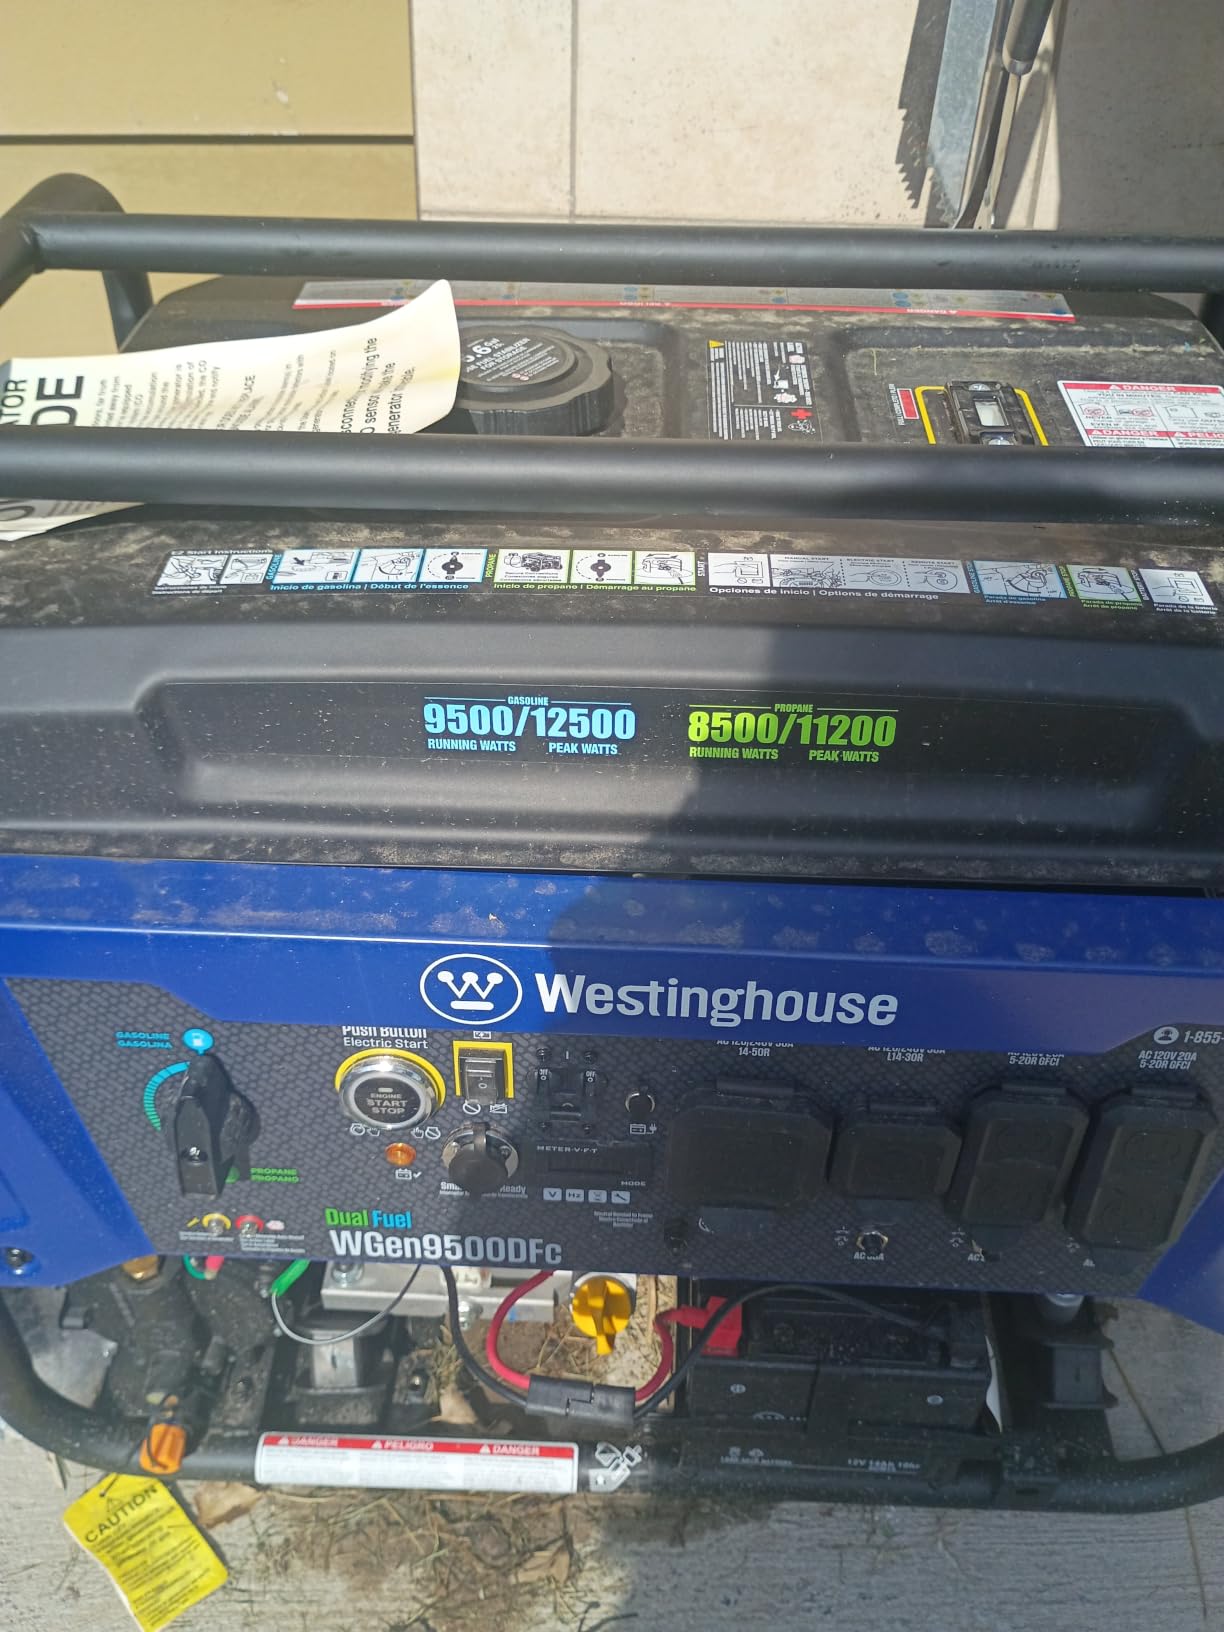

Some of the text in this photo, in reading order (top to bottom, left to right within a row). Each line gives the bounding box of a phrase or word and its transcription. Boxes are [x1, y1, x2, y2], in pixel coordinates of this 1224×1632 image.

[265, 553, 282, 580] GASOLINE
[485, 553, 497, 578] PROPANE
[697, 560, 706, 576] START
[586, 584, 639, 592] Démarrage
[656, 585, 697, 593] propane
[709, 586, 761, 595] Opciones
[764, 587, 777, 595] de
[819, 589, 861, 599] Options
[881, 591, 939, 600] démarrage
[507, 696, 549, 706] GASOLINE
[774, 703, 814, 713] PROPANE
[423, 703, 636, 740] 9500/12500
[688, 711, 897, 747] 8500/11200
[427, 738, 516, 752] RUNNING WATTS
[549, 742, 618, 755] PEAK WATTS
[689, 746, 779, 760] RUNNING WATTS
[808, 749, 880, 763] PEAK WATTS
[535, 973, 898, 1028] Westinghouse
[116, 1031, 170, 1040] GASOLINE
[117, 1040, 172, 1049] GASOLINA
[343, 1037, 428, 1049] Electric Start
[738, 1047, 770, 1057] 14-50R
[887, 1052, 924, 1063] L14-30R
[1139, 1050, 1197, 1061] AC 120V 20A
[1009, 1056, 1060, 1067] 5-20R GFCI
[1139, 1059, 1191, 1070] 5-20R GFCI
[366, 1099, 408, 1107] START
[371, 1107, 406, 1115] STOP
[251, 1175, 299, 1183] PROPANO
[325, 1207, 412, 1229] Dual Fuel
[329, 1230, 562, 1265] WGen9500DFc
[853, 1251, 866, 1260] AC
[383, 1440, 434, 1450] PELIGRO
[492, 1445, 540, 1456] DANGER
[85, 1484, 158, 1543] CAUTION
